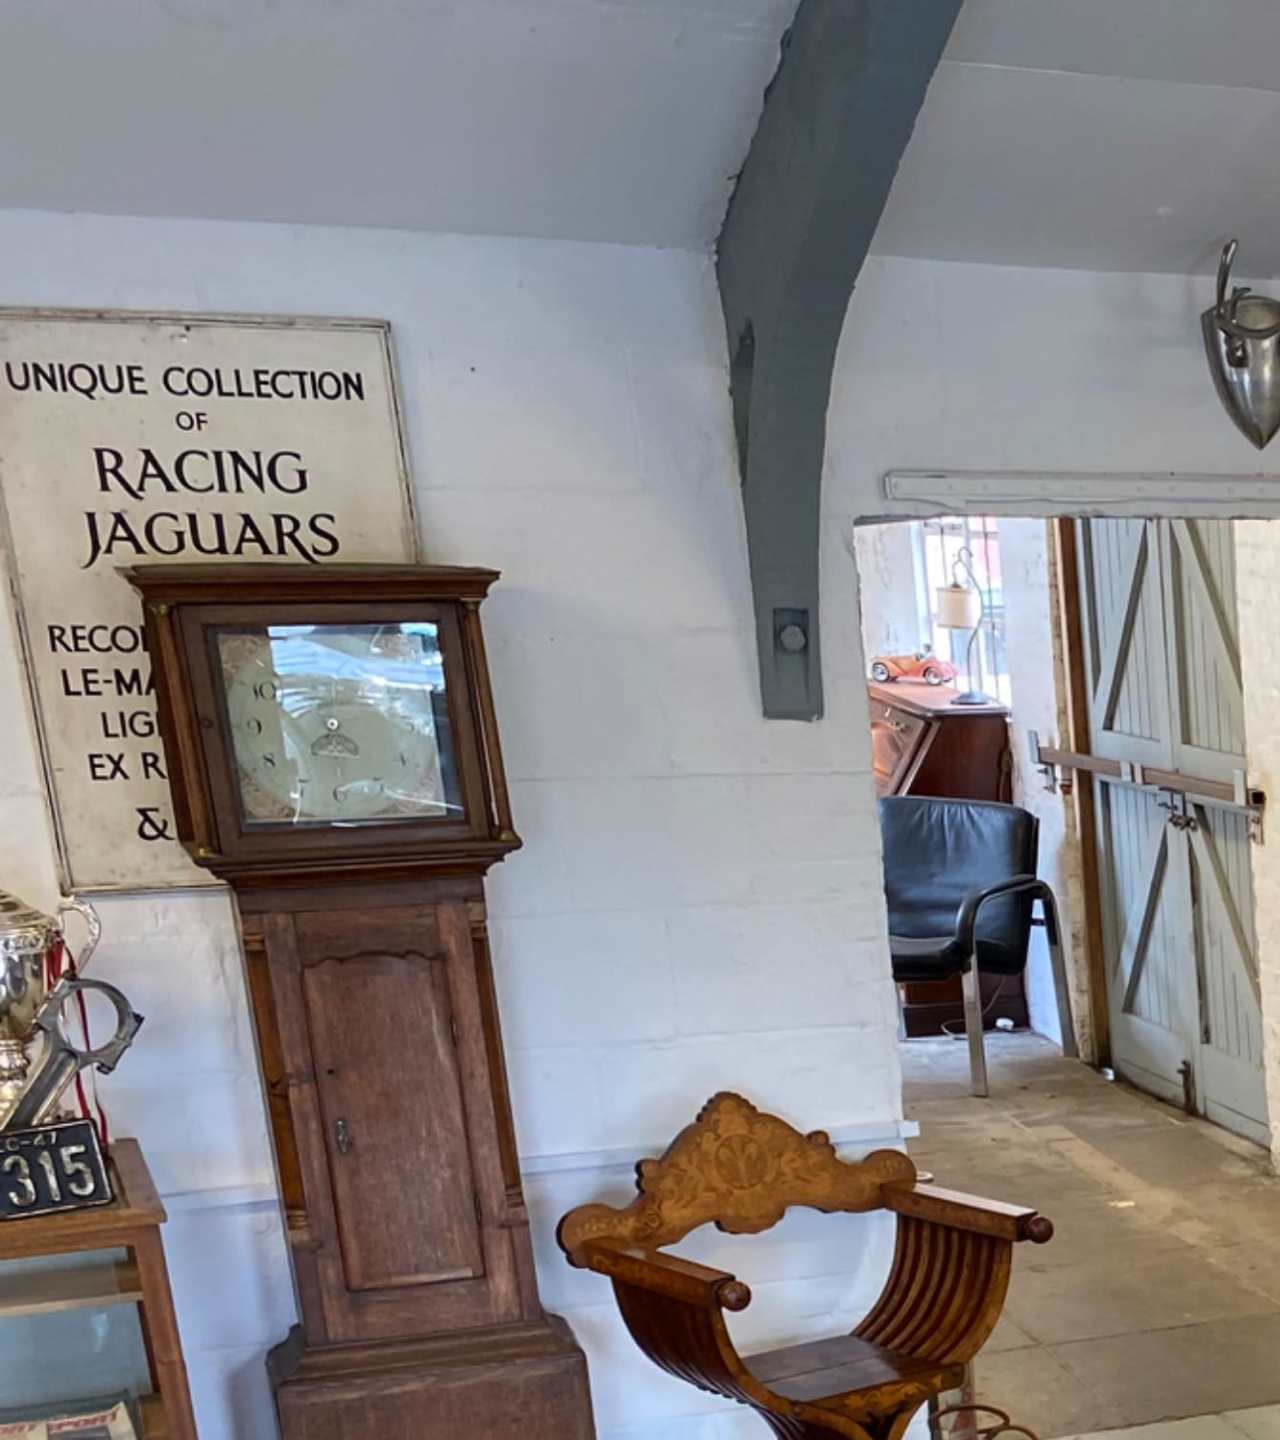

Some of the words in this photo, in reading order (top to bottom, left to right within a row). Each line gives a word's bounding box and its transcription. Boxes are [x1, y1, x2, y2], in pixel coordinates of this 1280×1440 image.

[5, 362, 148, 400] UNIQUE
[163, 366, 364, 401] COLLECTION
[175, 411, 208, 431] OF
[93, 447, 308, 500] RACING
[81, 511, 340, 569] JAGUARS
[101, 710, 160, 738] LIG
[88, 753, 130, 780] EX
[136, 807, 176, 841] &
[2, 1144, 96, 1207] 315
